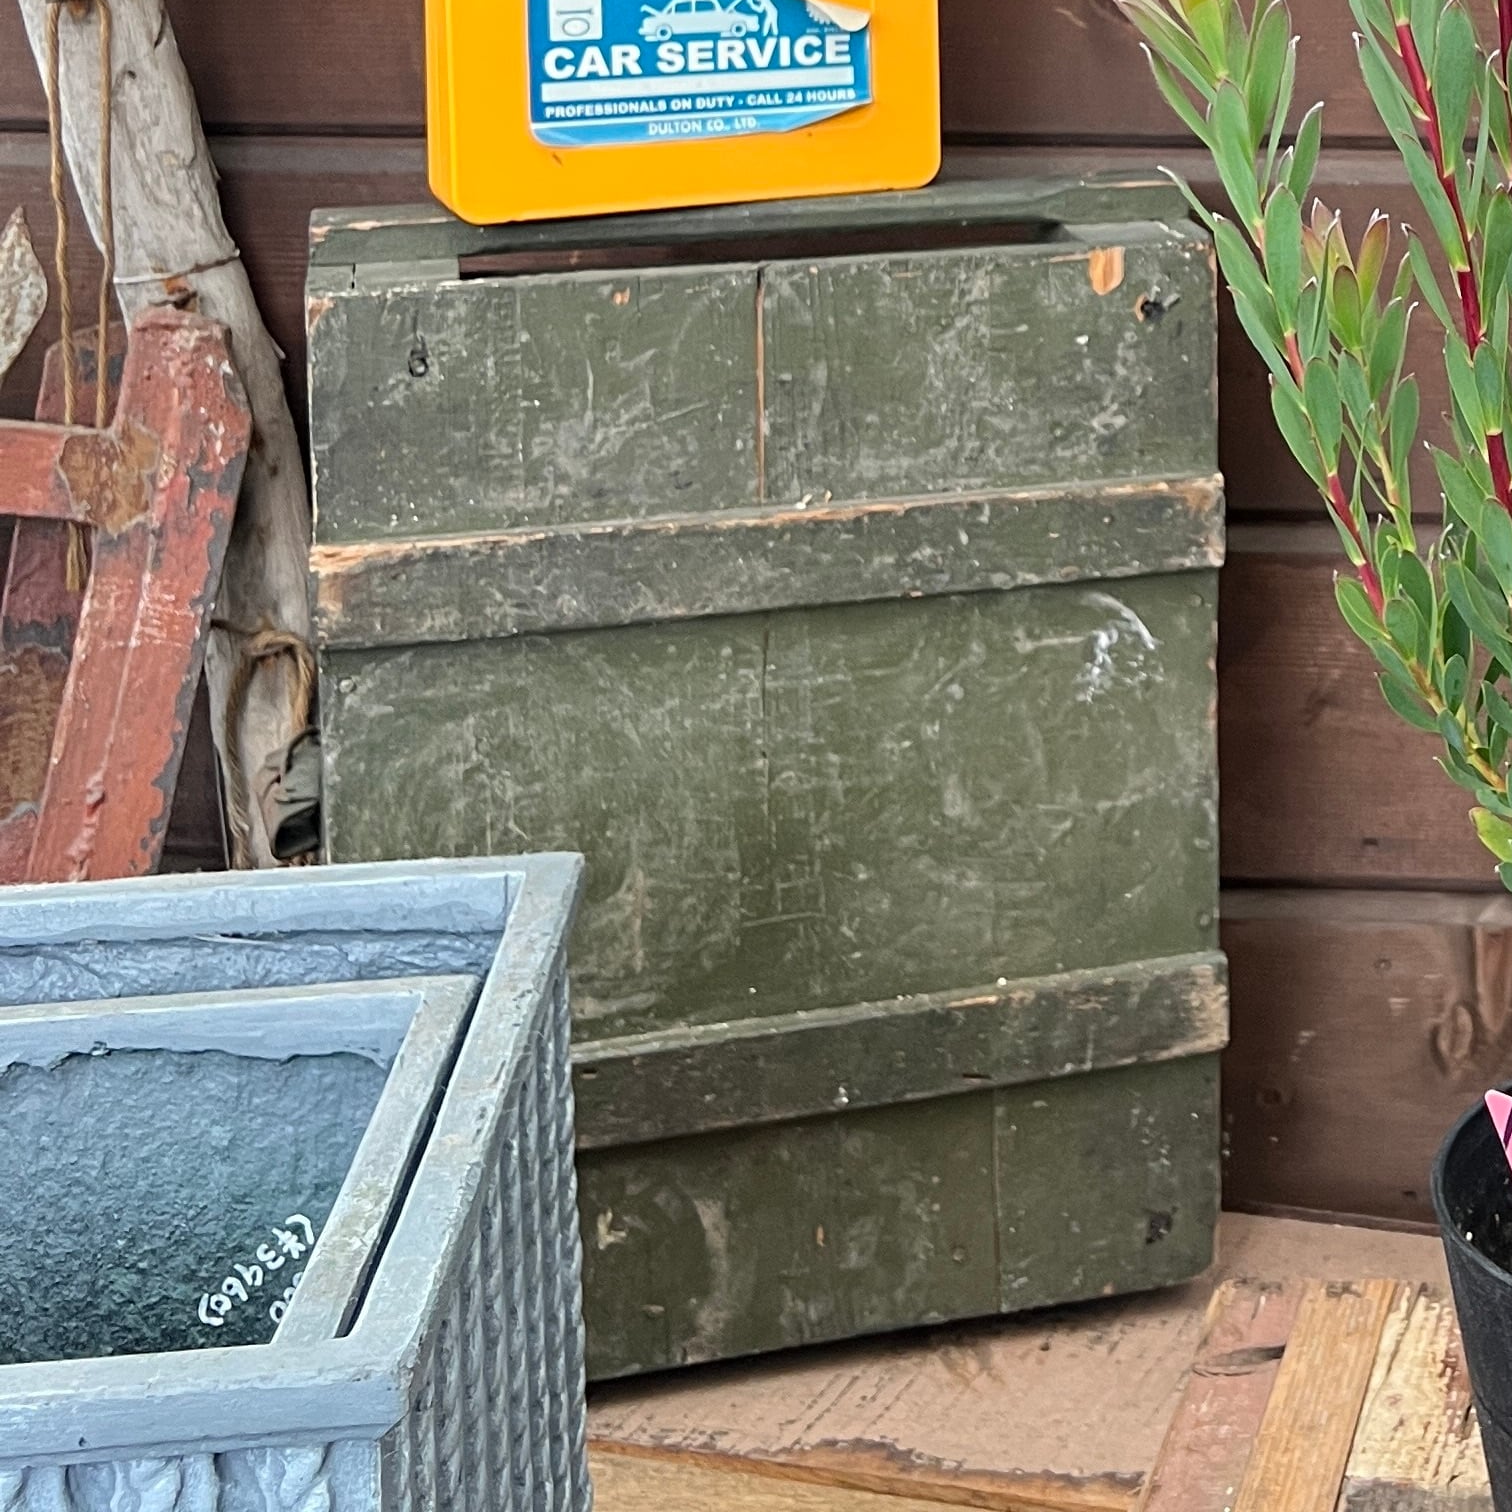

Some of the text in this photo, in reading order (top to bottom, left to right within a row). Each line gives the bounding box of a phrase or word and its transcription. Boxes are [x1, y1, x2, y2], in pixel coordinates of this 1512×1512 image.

[543, 34, 850, 80] CAR SERVICE
[544, 88, 857, 119] PROFESSIONALS ON DUTY CALL 24 HOURS
[648, 120, 702, 136] DULTON
